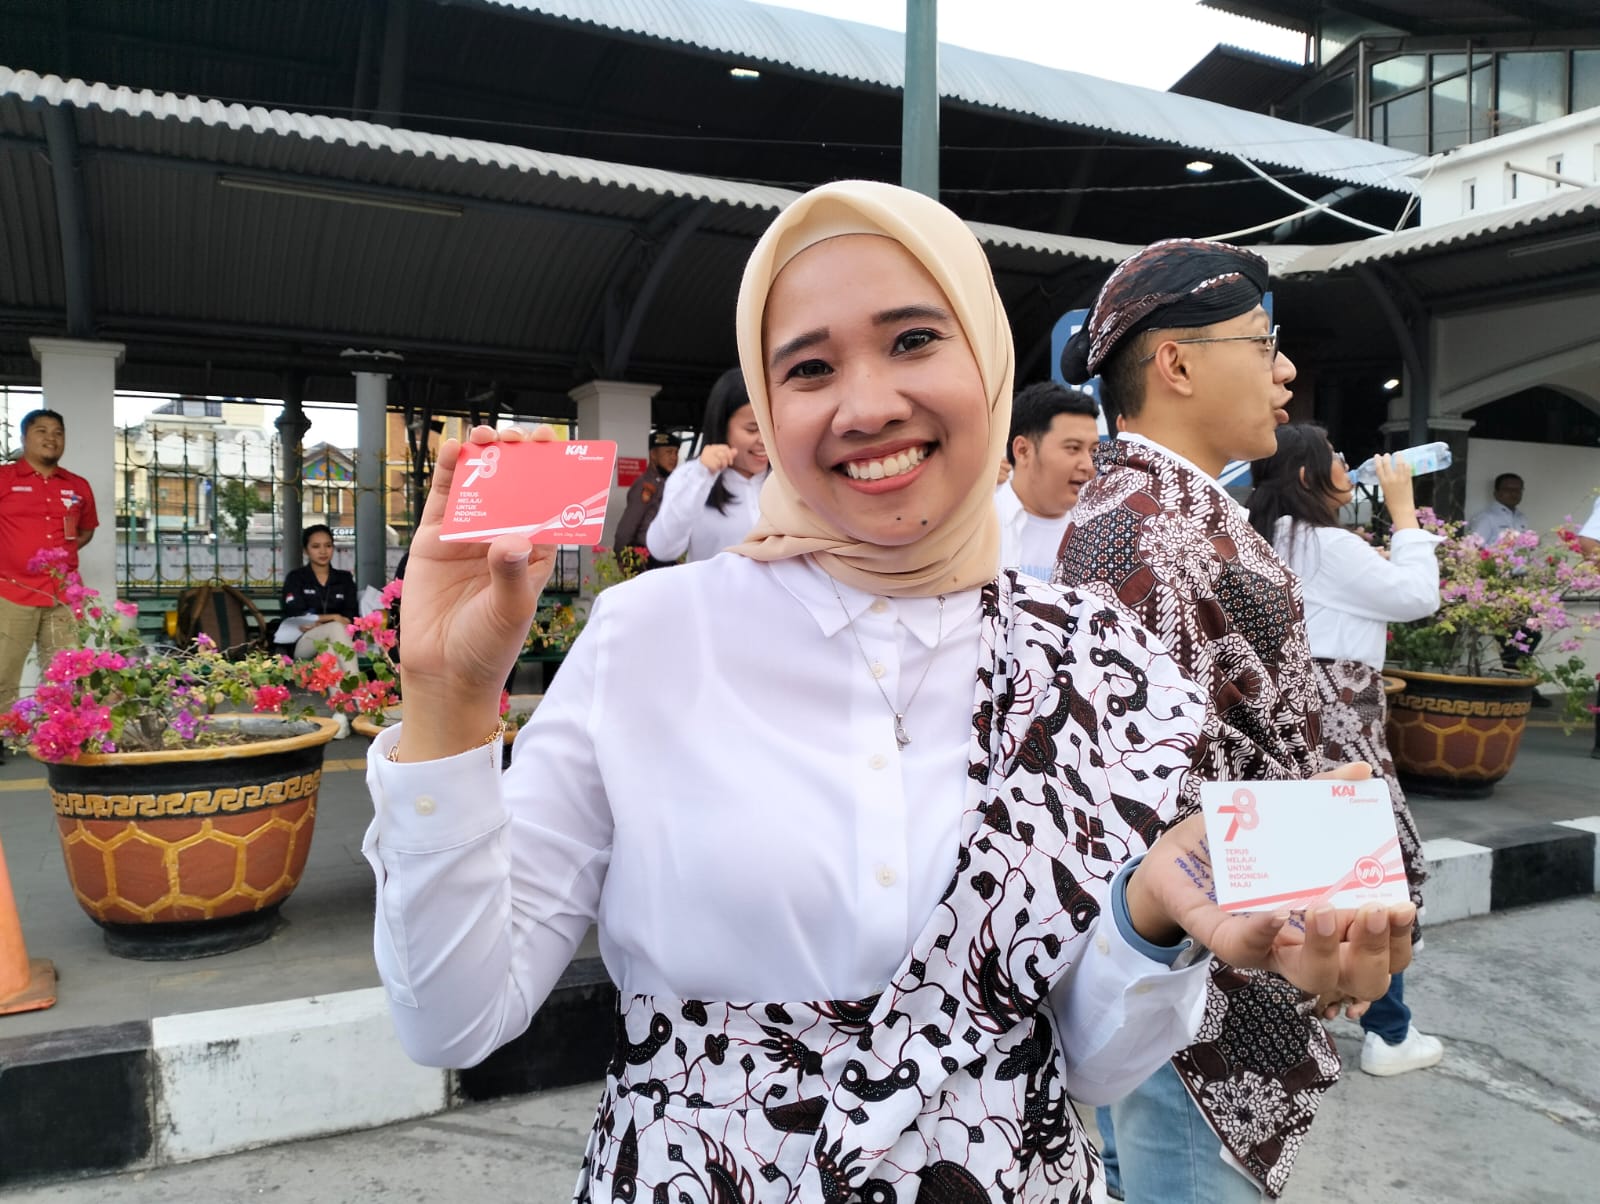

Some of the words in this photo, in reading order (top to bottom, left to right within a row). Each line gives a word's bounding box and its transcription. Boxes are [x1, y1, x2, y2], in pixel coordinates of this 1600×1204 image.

[565, 445, 588, 455] KAI
[457, 497, 482, 505] MELAJU
[1331, 785, 1356, 797] KAI
[1225, 856, 1257, 864] MELAJU
[1228, 872, 1270, 881] INDONESIA
[1231, 881, 1252, 889] MAJU
